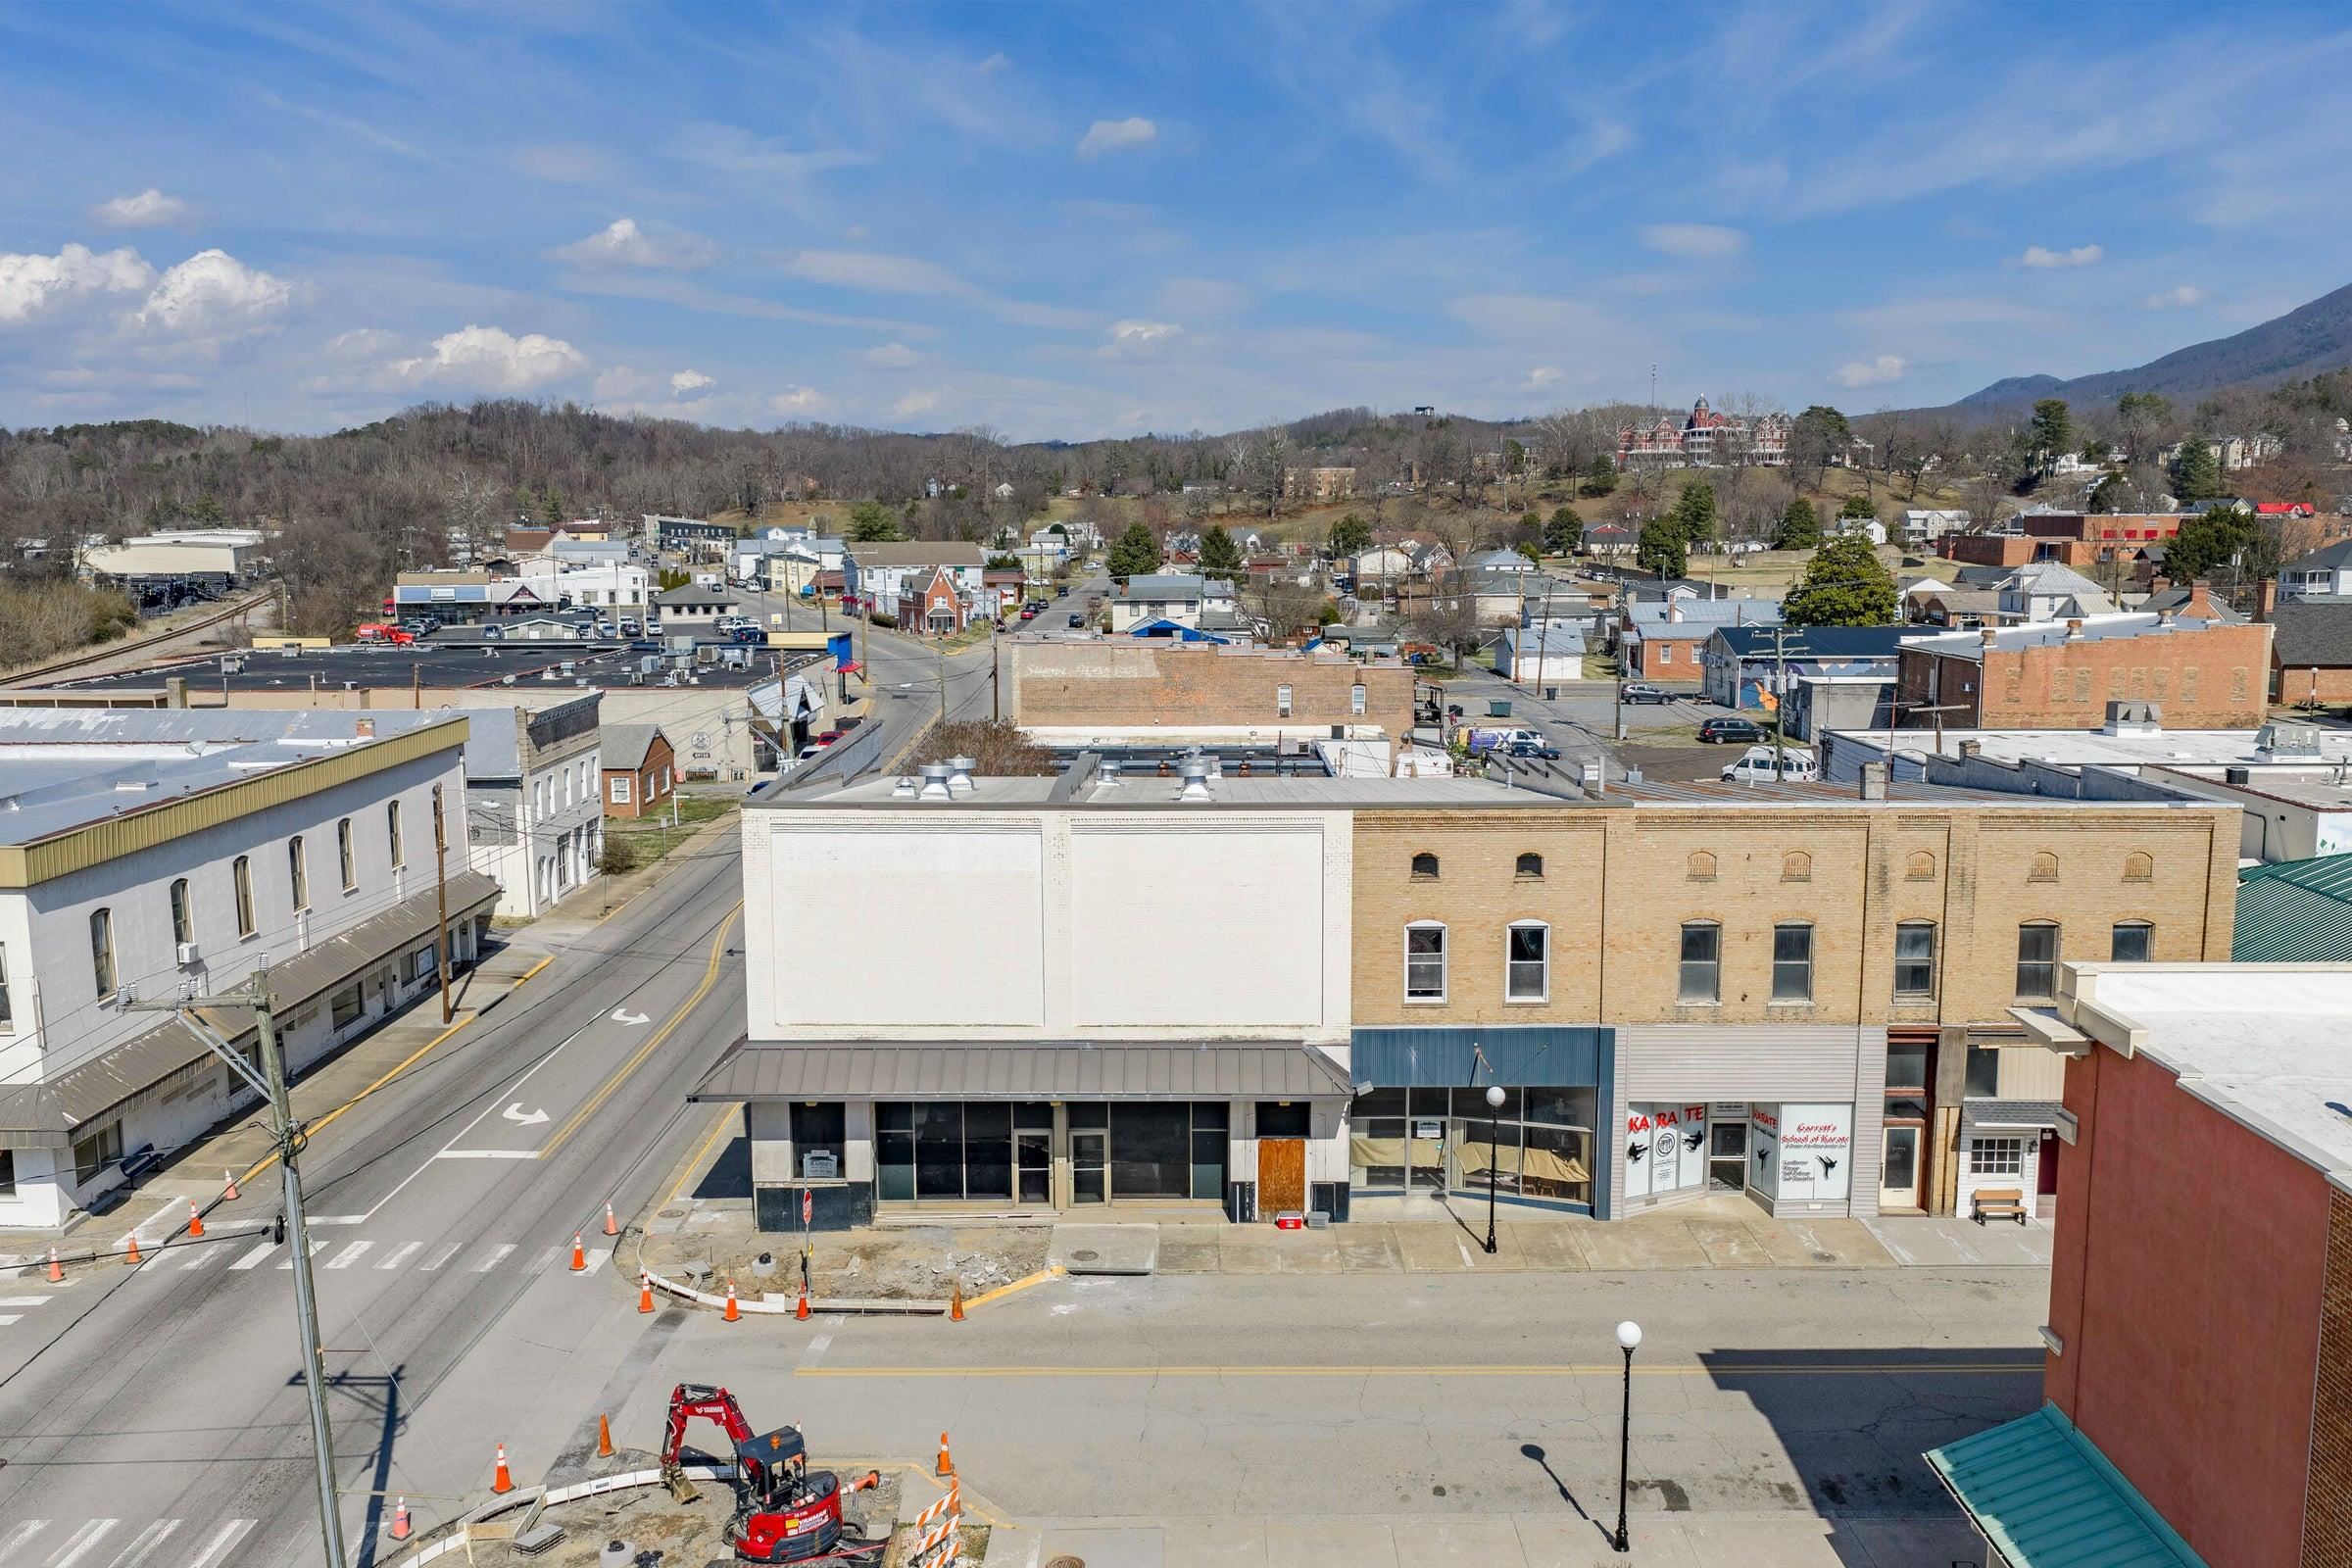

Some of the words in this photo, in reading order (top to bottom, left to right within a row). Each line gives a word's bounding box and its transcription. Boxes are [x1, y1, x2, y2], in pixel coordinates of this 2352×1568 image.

[1796, 1123, 1837, 1133] Garrett's
[1781, 1135, 1808, 1144] School
[1810, 1135, 1820, 1144] of
[1821, 1135, 1849, 1144] Karate
[799, 1508, 827, 1526] YANMAR
